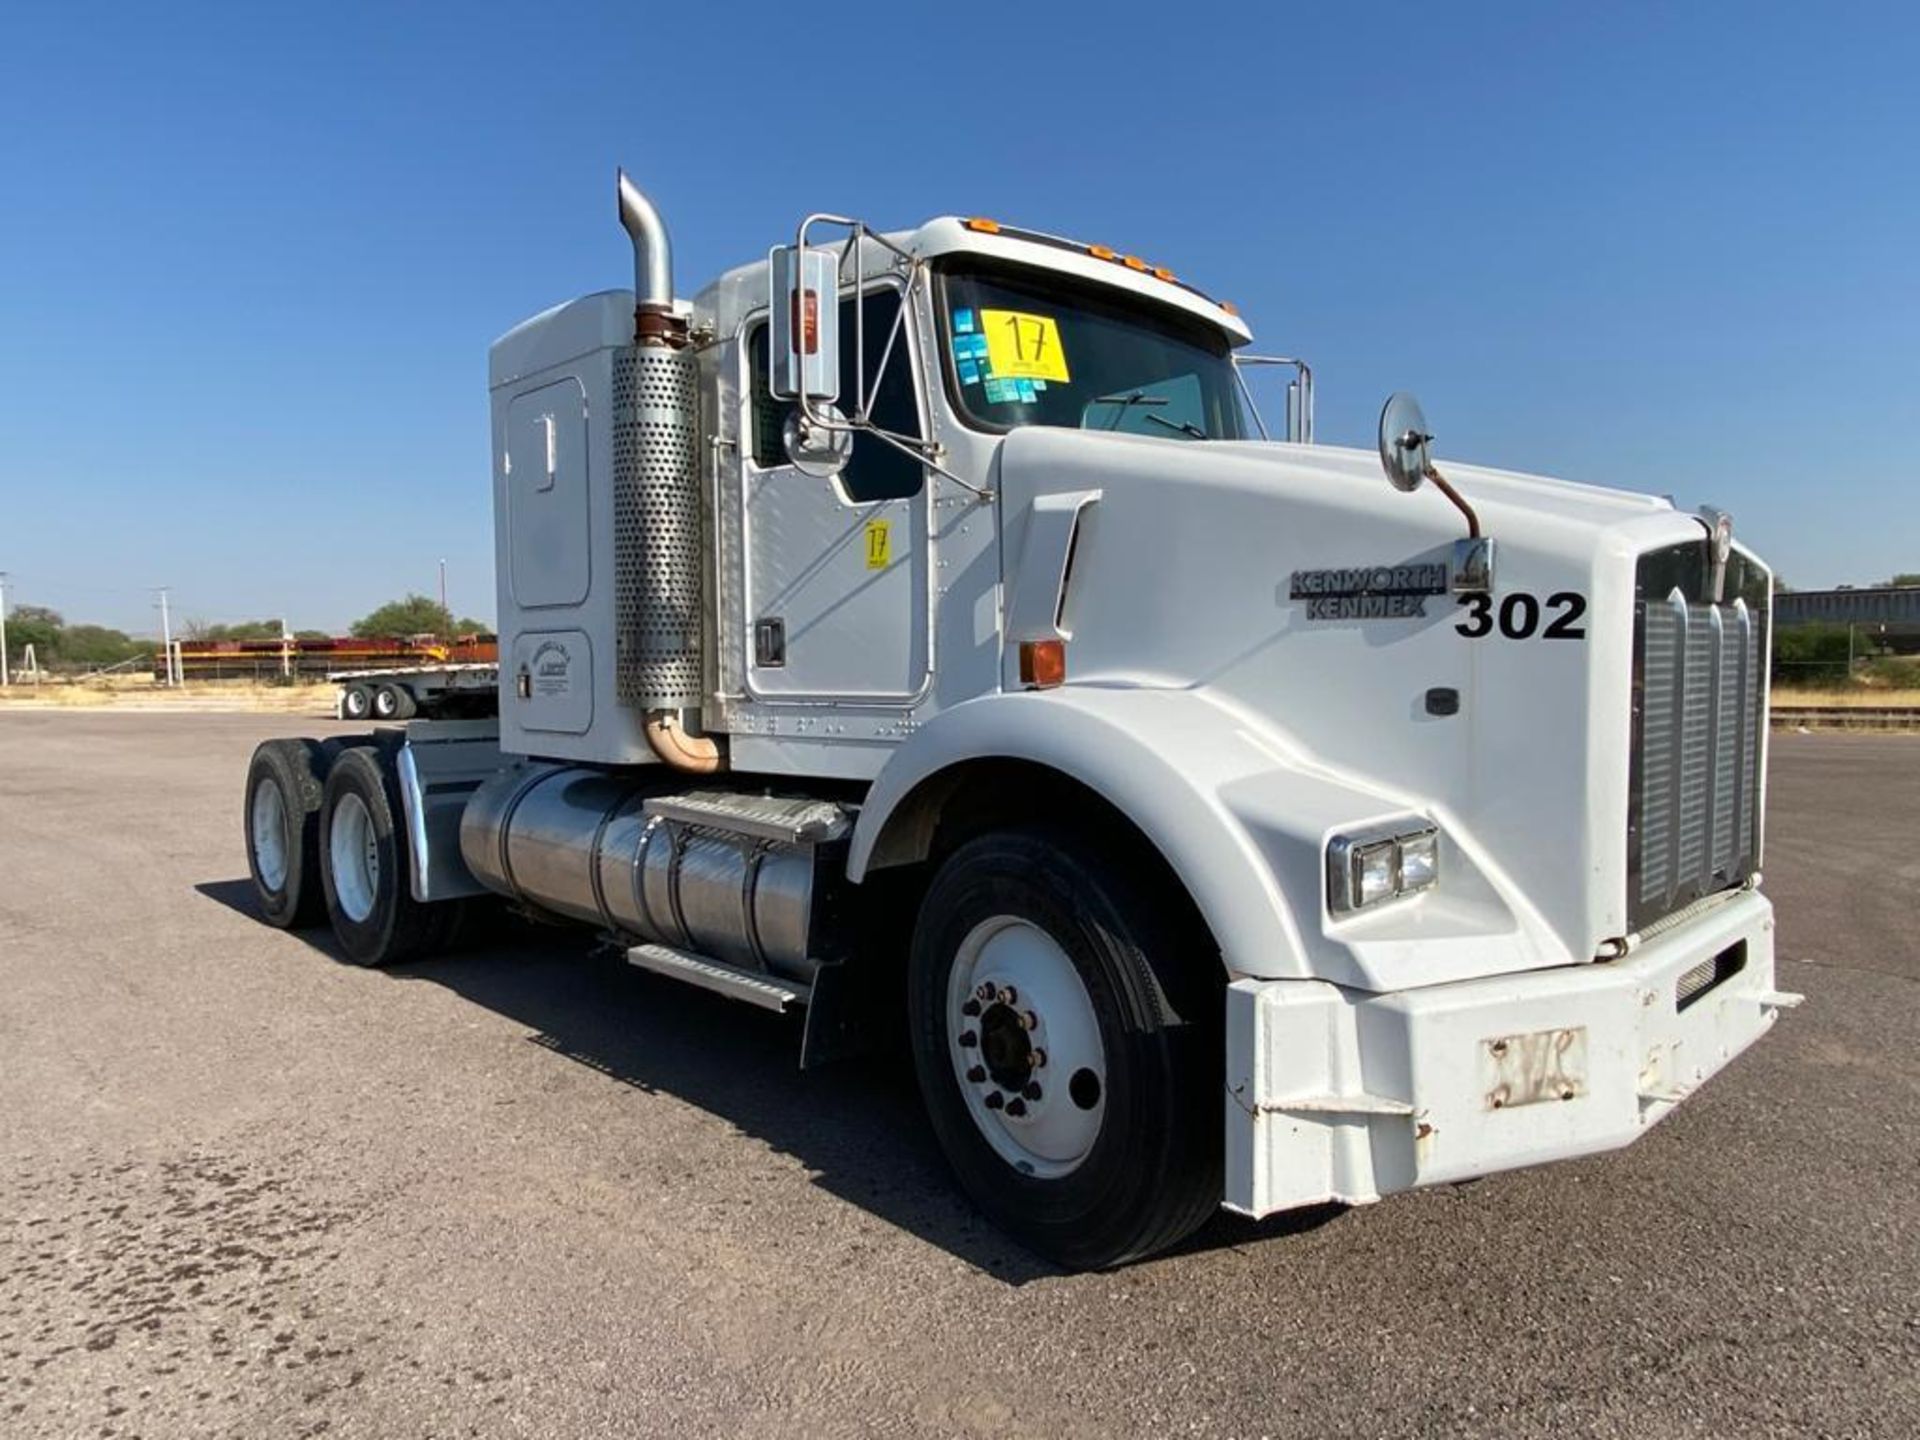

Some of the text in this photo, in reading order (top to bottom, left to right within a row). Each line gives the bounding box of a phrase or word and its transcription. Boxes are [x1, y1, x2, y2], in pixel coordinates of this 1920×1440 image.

[1005, 315, 1047, 362] 17
[869, 527, 888, 557] 17
[1290, 564, 1447, 598] KENWORTH
[1306, 596, 1426, 620] KENMEX
[1454, 591, 1587, 640] 302
